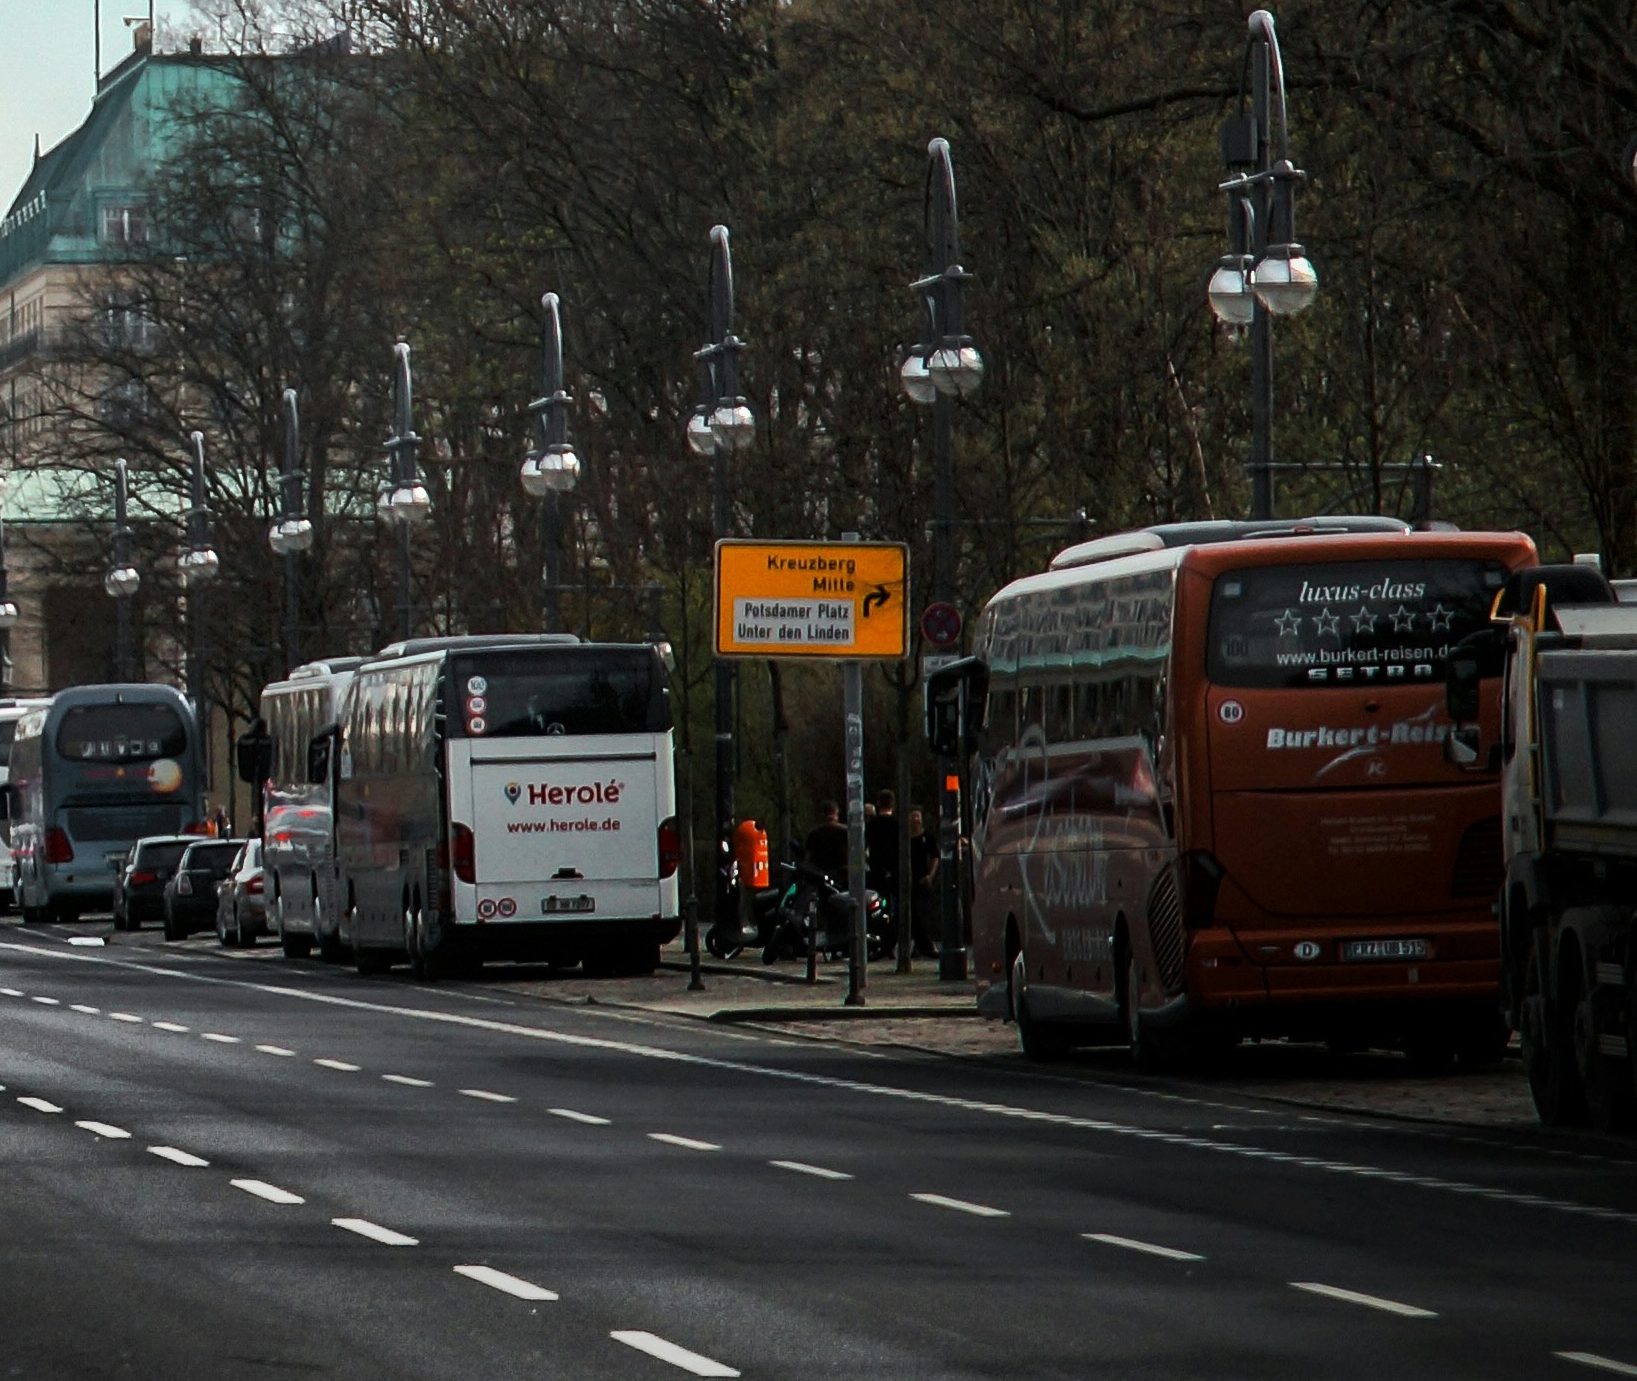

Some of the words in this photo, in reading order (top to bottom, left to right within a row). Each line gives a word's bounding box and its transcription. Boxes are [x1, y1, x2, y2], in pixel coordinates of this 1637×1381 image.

[767, 555, 856, 574] Kreuzberg
[812, 577, 855, 592] Mitte
[1299, 577, 1426, 604] luxus-class
[744, 602, 812, 618] Potsdamer
[818, 602, 849, 618] Platz
[737, 623, 772, 639] Unter
[778, 624, 802, 639] den
[807, 624, 850, 639] Linden
[1266, 721, 1480, 750] Burkert-Reis
[527, 778, 621, 805] Herolé
[507, 817, 621, 833] www.herole.de
[1302, 943, 1314, 957] D
